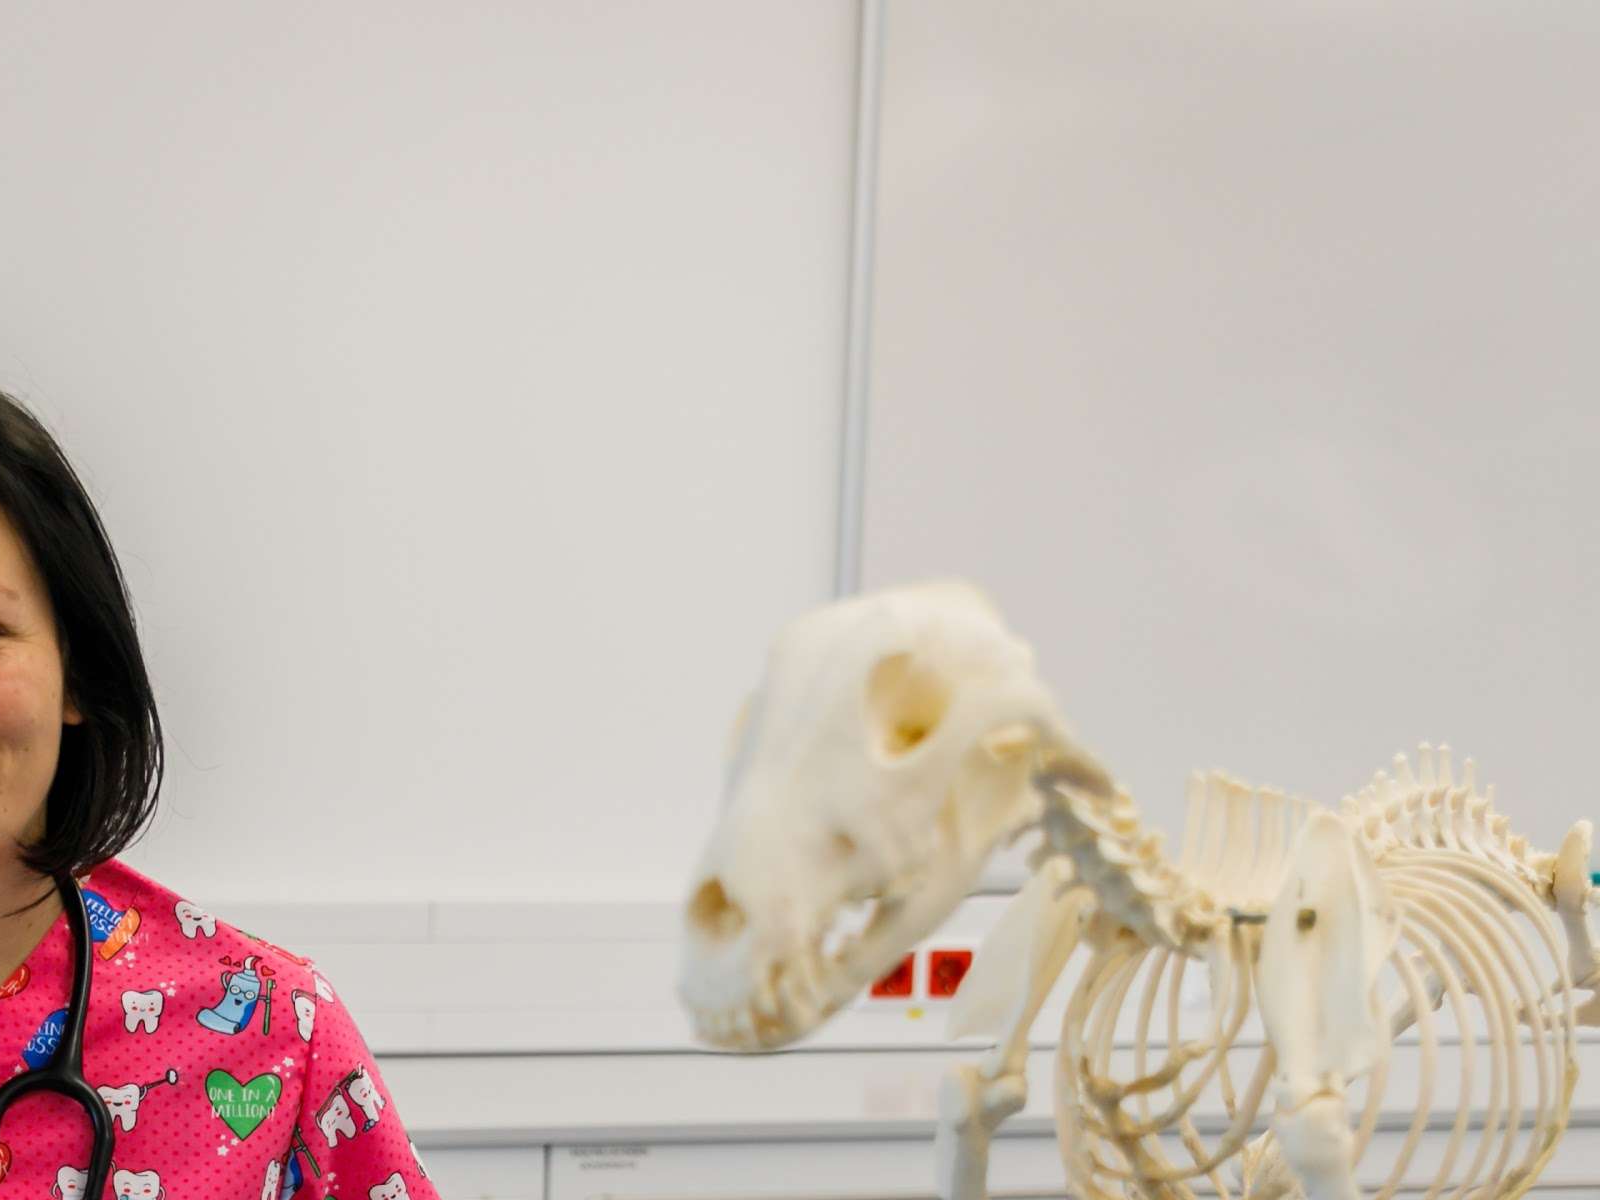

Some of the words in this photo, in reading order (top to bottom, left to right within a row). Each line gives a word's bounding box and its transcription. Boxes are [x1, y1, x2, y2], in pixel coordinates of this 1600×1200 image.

[208, 1087, 234, 1103] ONE
[242, 1087, 261, 1102] IN
[266, 1089, 279, 1104] A
[211, 1103, 276, 1121] MILLION!
